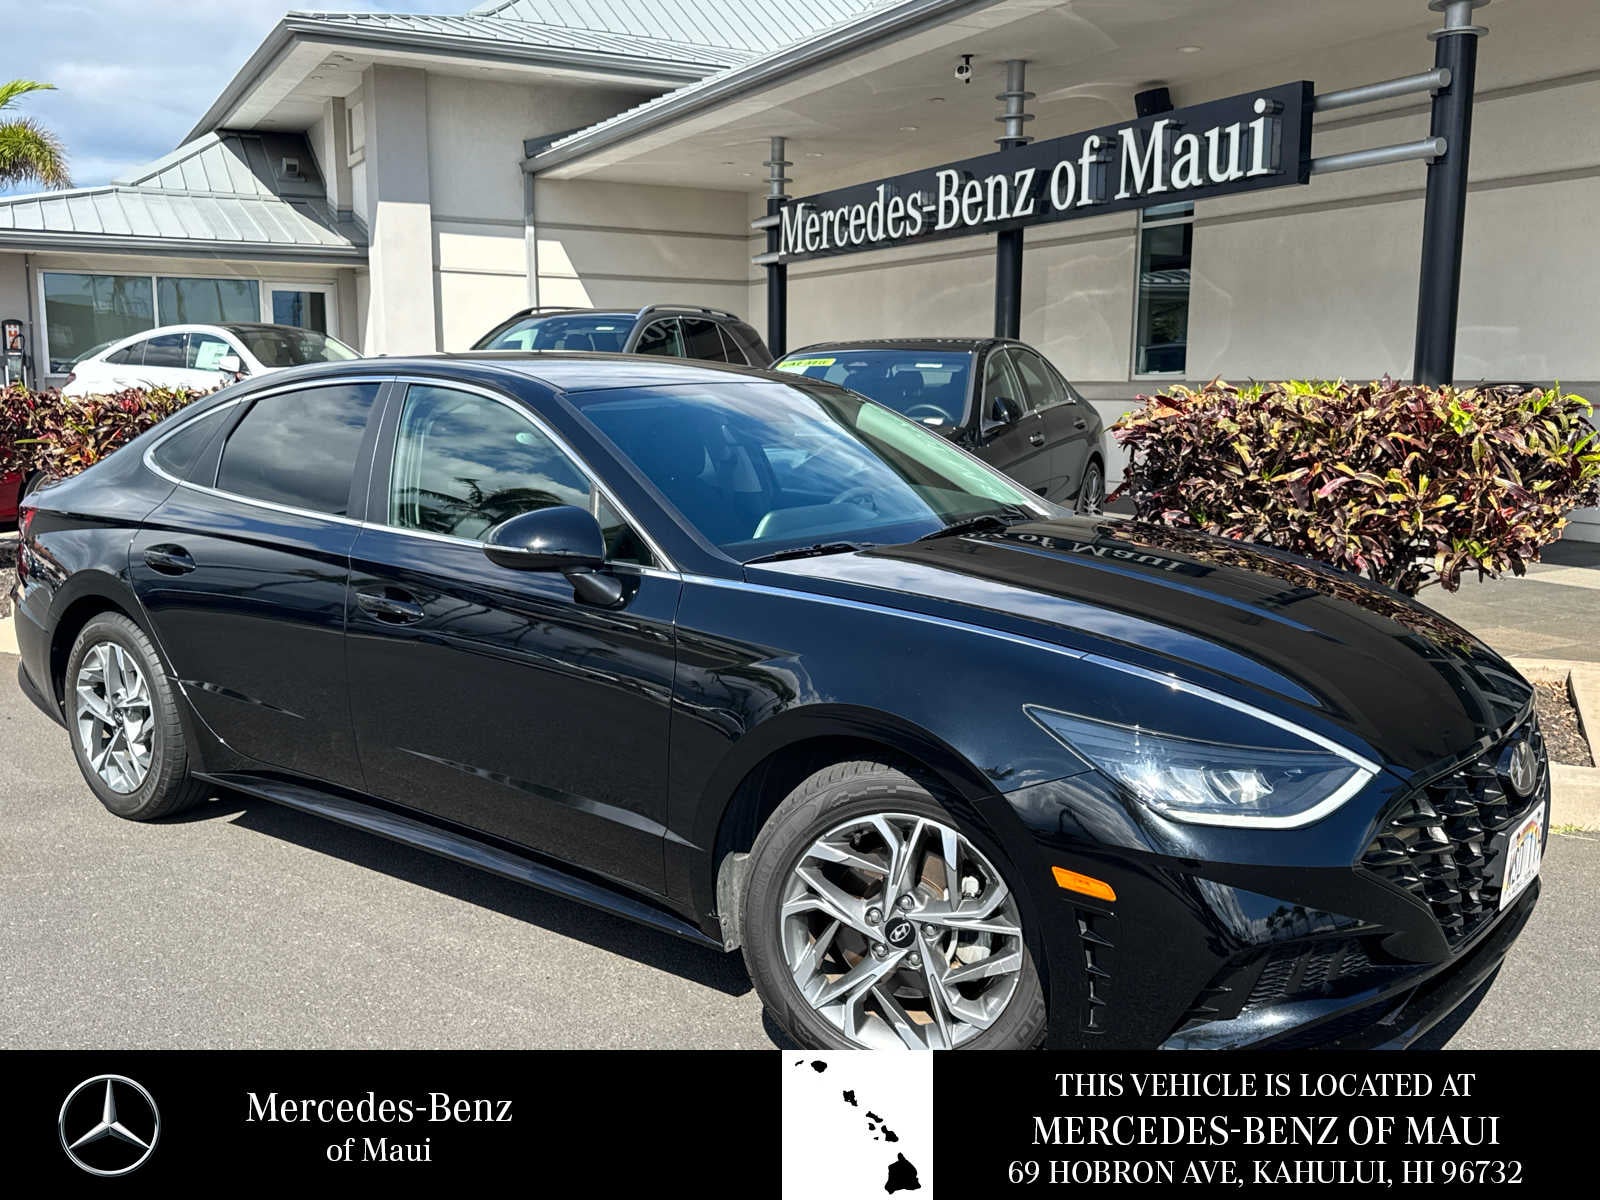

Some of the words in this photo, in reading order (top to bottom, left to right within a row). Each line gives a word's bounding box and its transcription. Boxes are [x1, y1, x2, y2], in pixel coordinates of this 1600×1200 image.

[778, 168, 1035, 256] Mercedes-Benz
[1050, 135, 1100, 210] of
[1114, 97, 1268, 200] Maui
